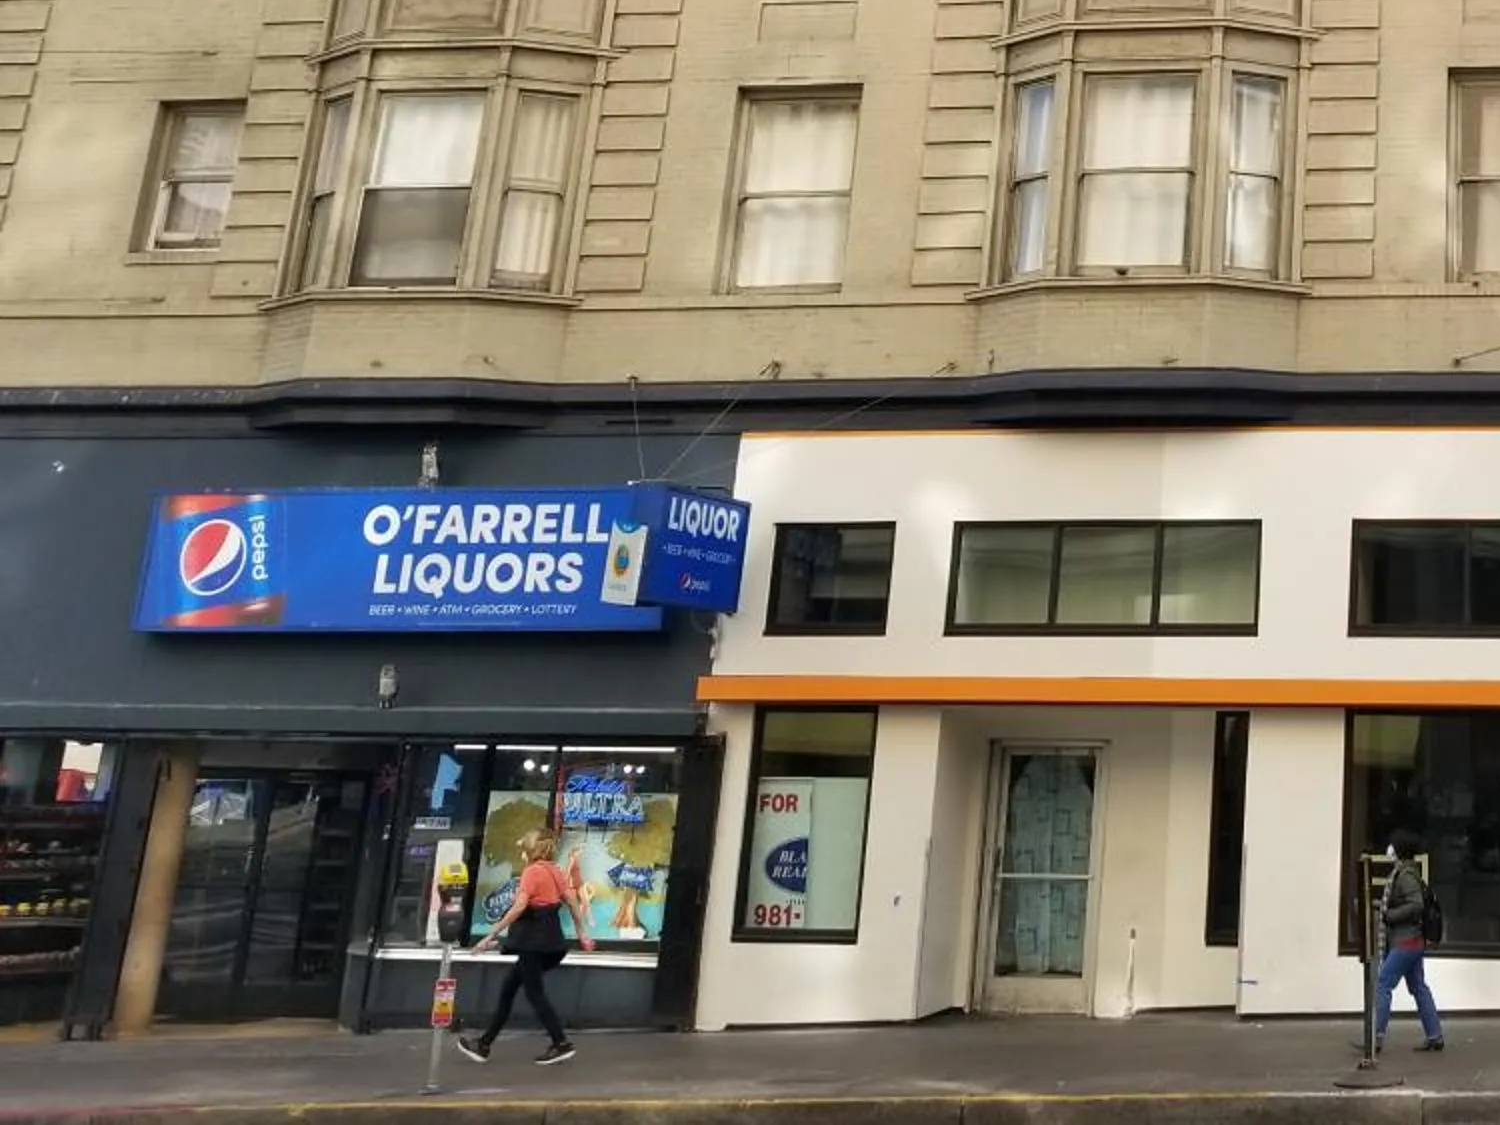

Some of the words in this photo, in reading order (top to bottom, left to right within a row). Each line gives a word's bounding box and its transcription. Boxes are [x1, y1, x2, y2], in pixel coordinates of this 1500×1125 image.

[363, 503, 609, 546] O'FARRELL
[668, 497, 740, 542] LIQUOR
[249, 514, 269, 581] pepsi
[372, 552, 584, 598] LIQUORS
[369, 604, 395, 616] BEER
[404, 604, 430, 616] WINE
[438, 604, 463, 616] ATM
[471, 604, 522, 616] GROCERY
[530, 604, 577, 616] LOTTERY
[759, 793, 798, 814] FOR
